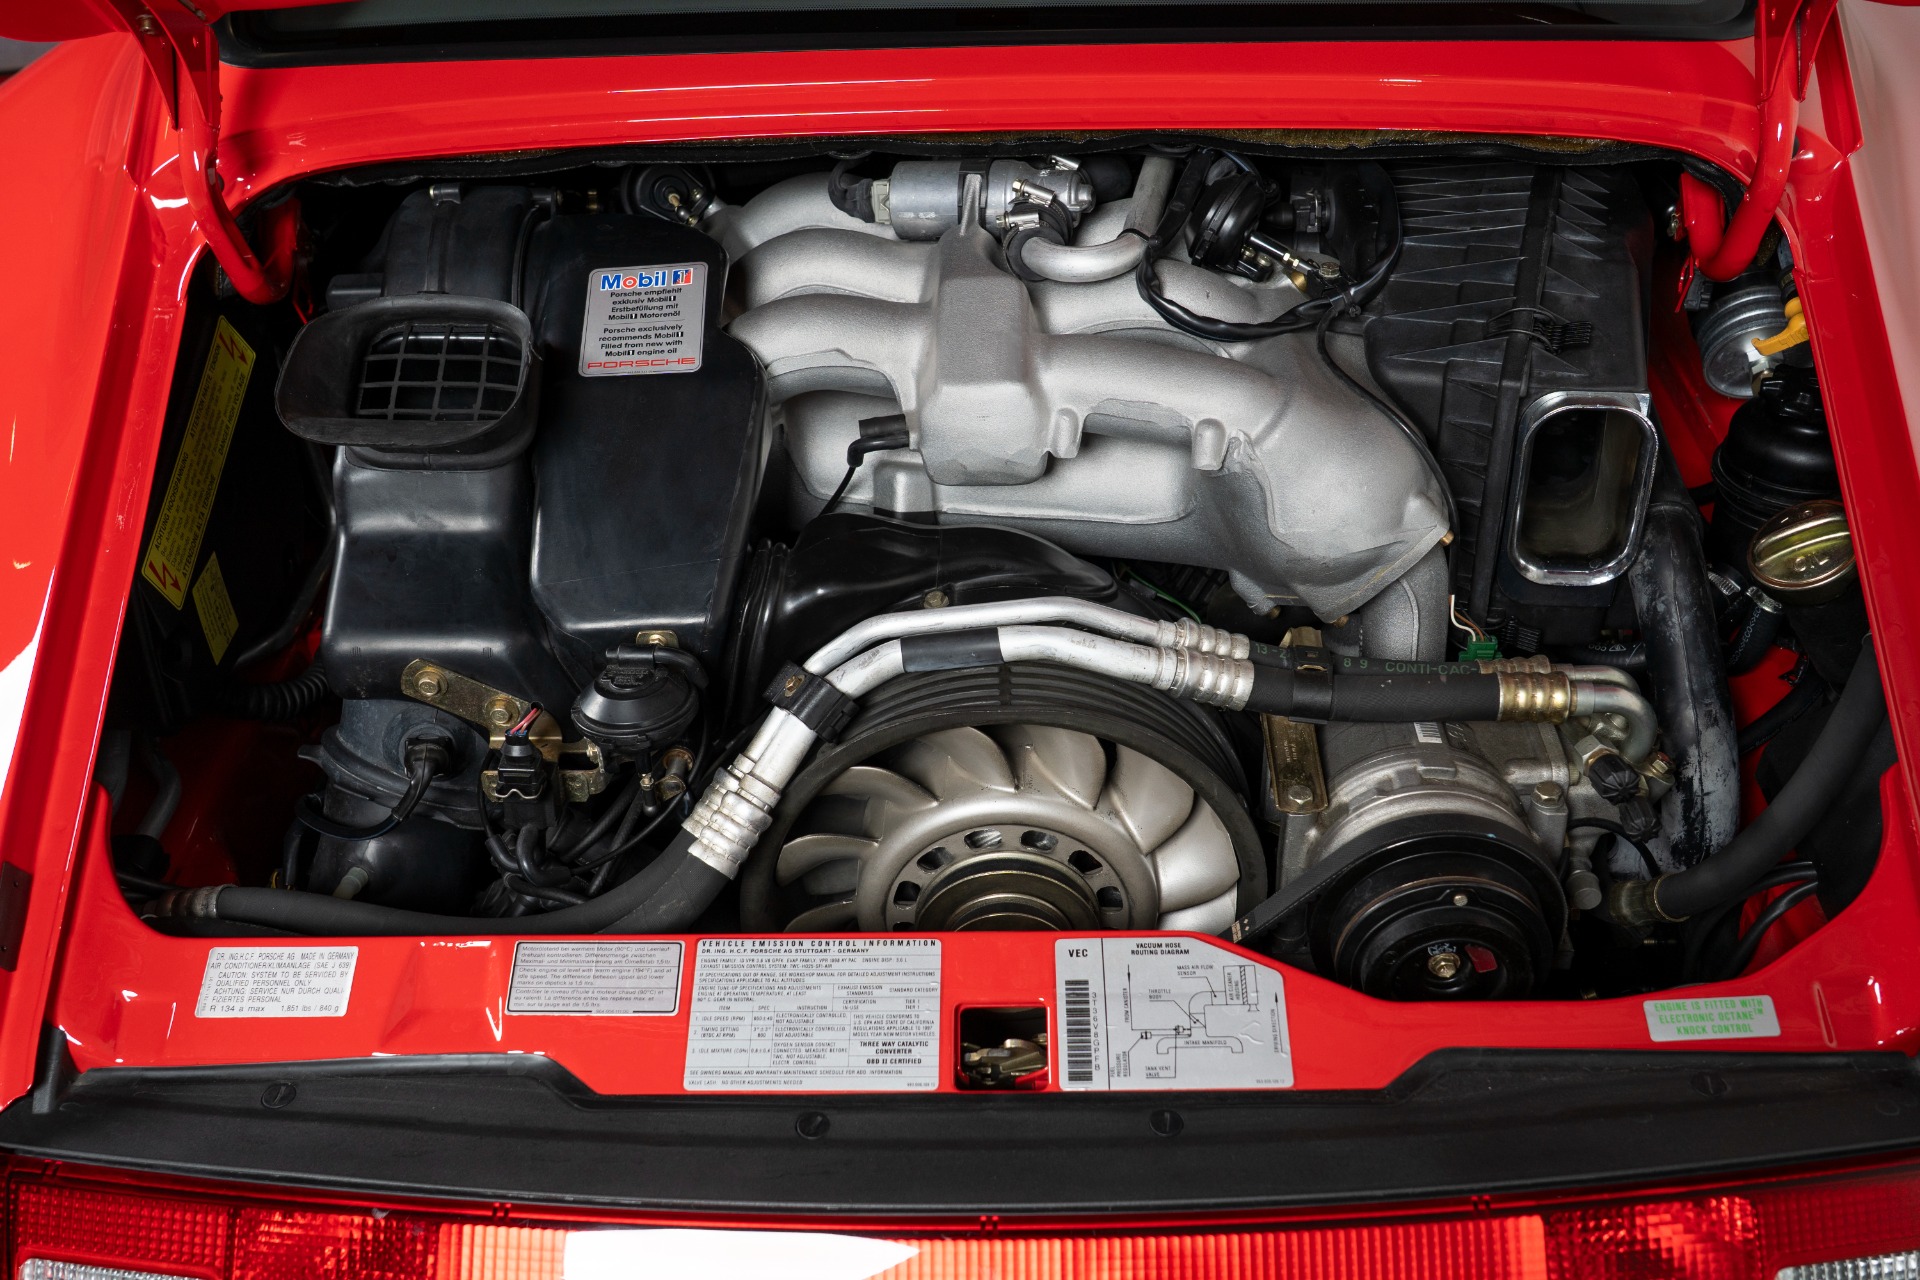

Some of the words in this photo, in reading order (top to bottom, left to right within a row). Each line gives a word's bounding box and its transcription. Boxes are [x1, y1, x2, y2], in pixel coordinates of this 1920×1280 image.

[601, 270, 667, 291] Mobil
[588, 358, 695, 369] PORSCHE
[1069, 949, 1088, 957] VEC
[1654, 1002, 1688, 1012] ENGINE
[1691, 1001, 1700, 1010] IS
[1704, 1000, 1736, 1009] FITTED
[1740, 998, 1763, 1008] WITH
[1659, 1013, 1714, 1024] ELECTRONIC
[1676, 1025, 1708, 1035] KNOCK
[1712, 1024, 1754, 1034] CONTROL
